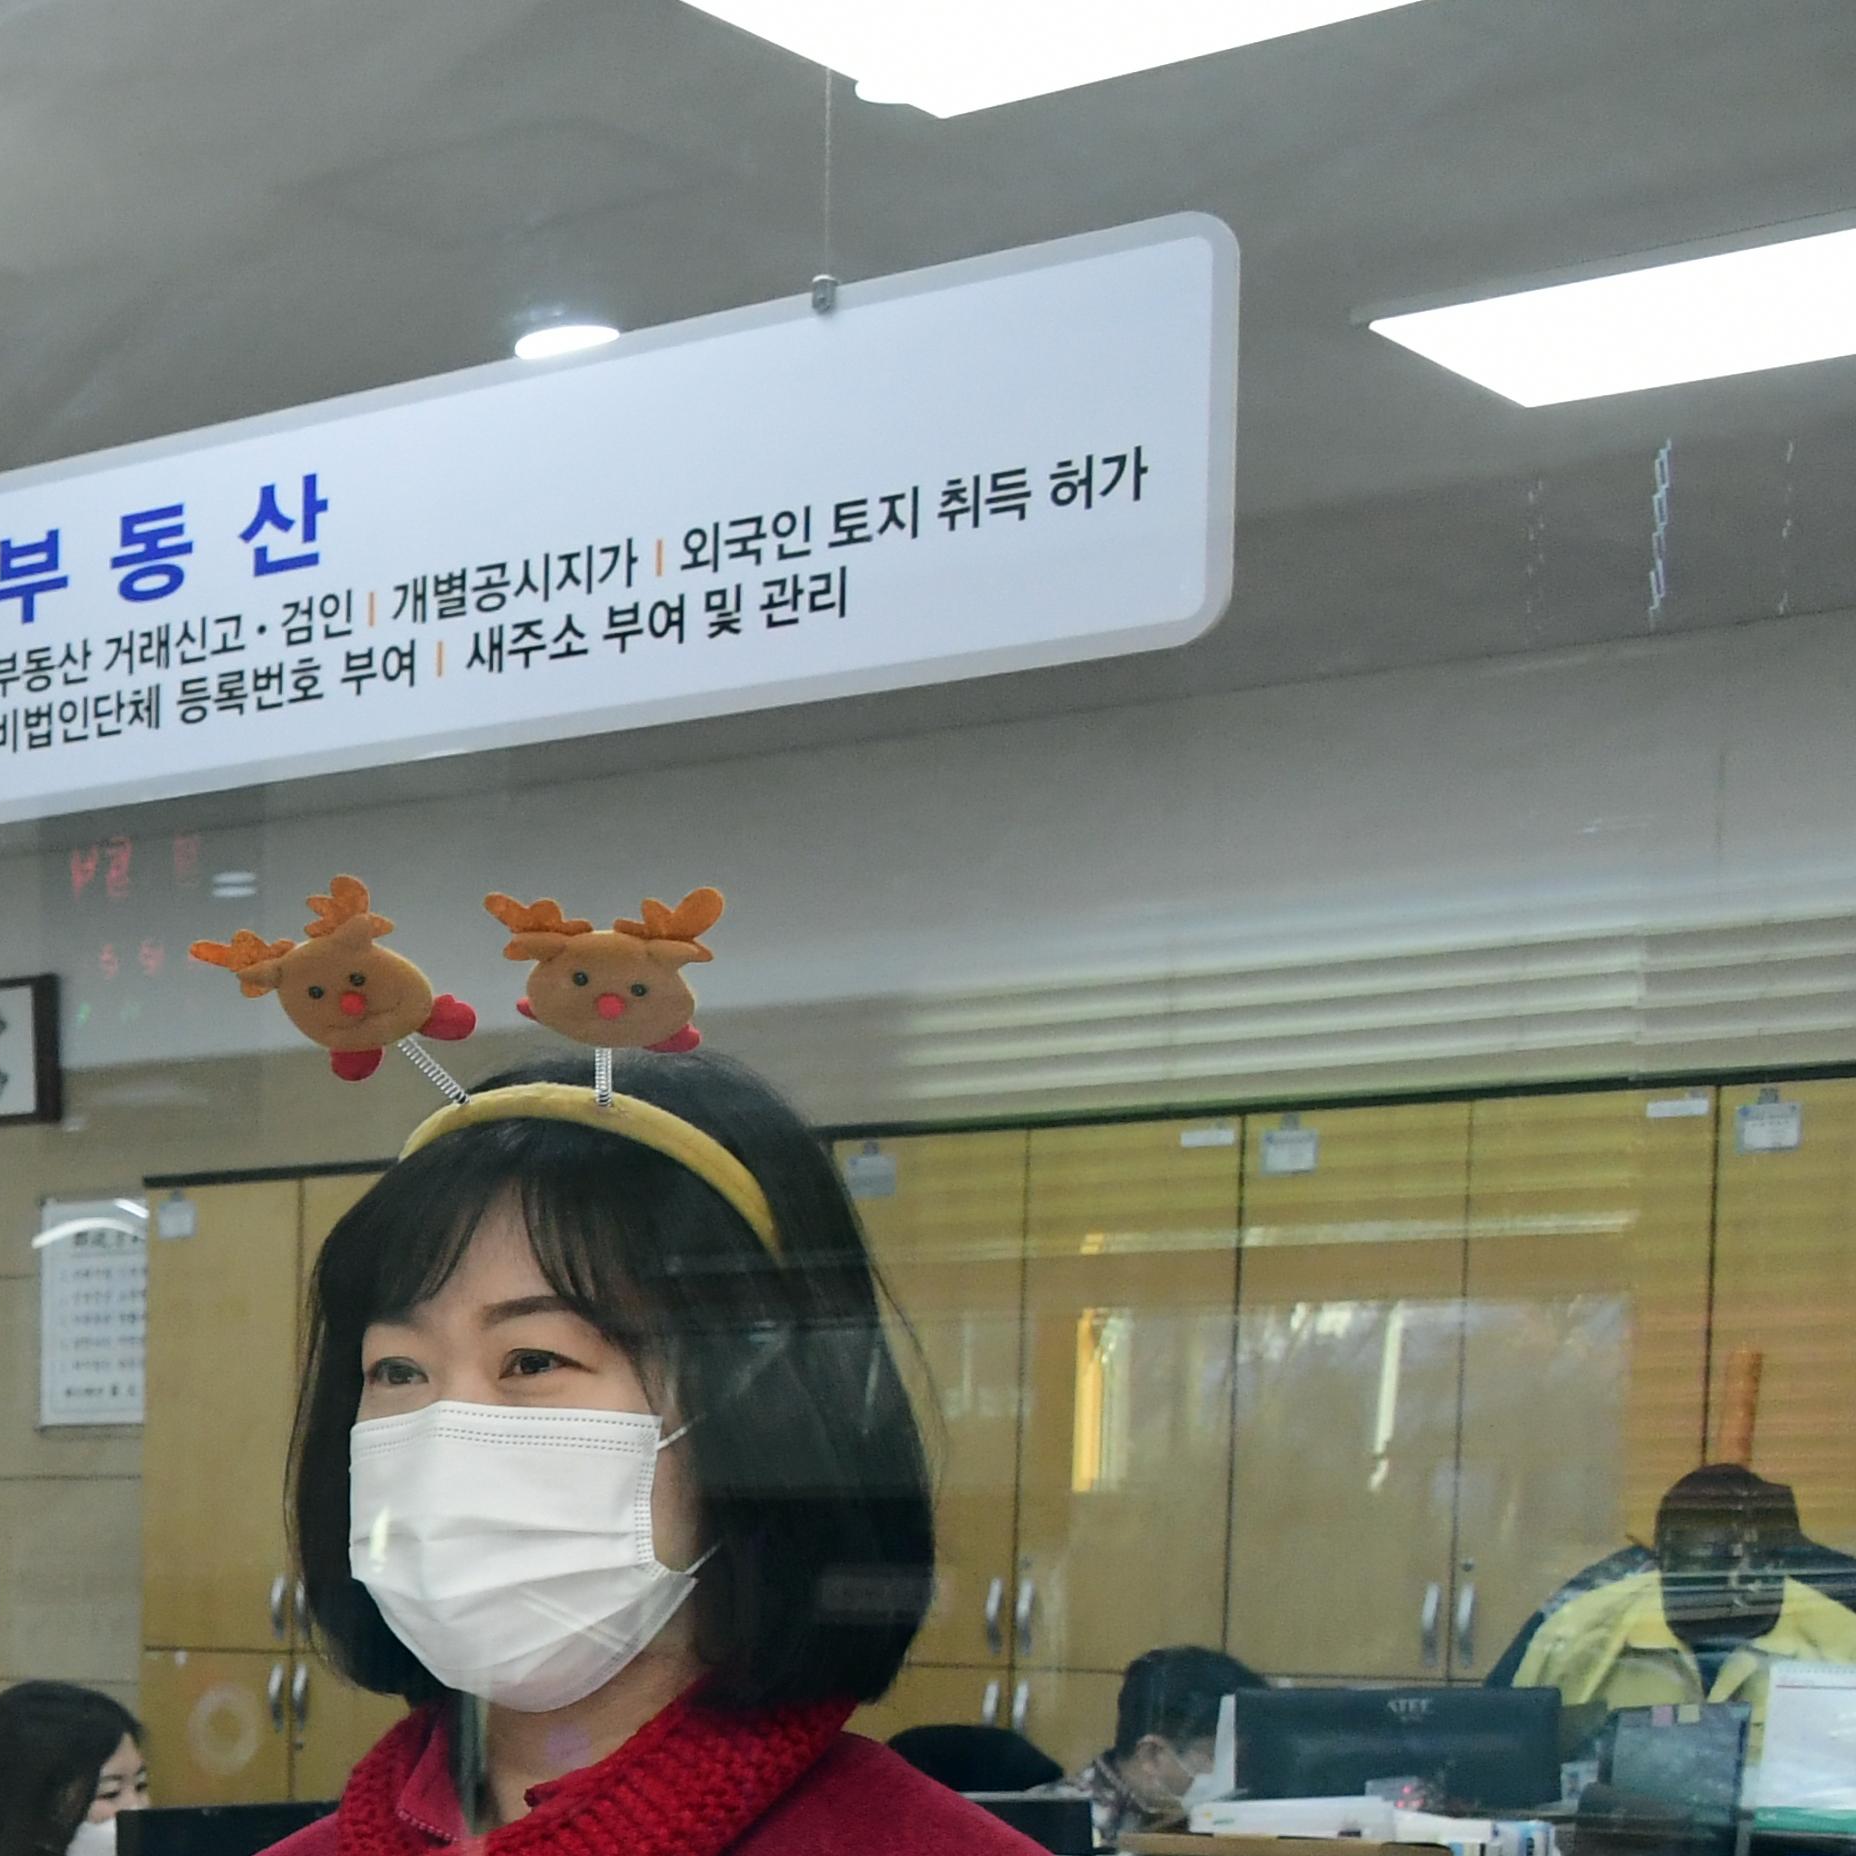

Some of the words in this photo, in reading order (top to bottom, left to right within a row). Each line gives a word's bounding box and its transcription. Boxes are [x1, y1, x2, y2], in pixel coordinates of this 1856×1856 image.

[392, 537, 638, 628] 개별공시지가
[680, 505, 812, 574] 외국인
[828, 485, 919, 550] 토지
[938, 467, 1031, 532] 취득
[1050, 445, 1147, 511] 허가
[177, 656, 324, 724] 등록번호
[341, 639, 416, 698] 부여
[466, 614, 589, 676] 새주소
[603, 593, 685, 654] 부여
[705, 583, 742, 639] 및
[760, 566, 847, 629] 관리
